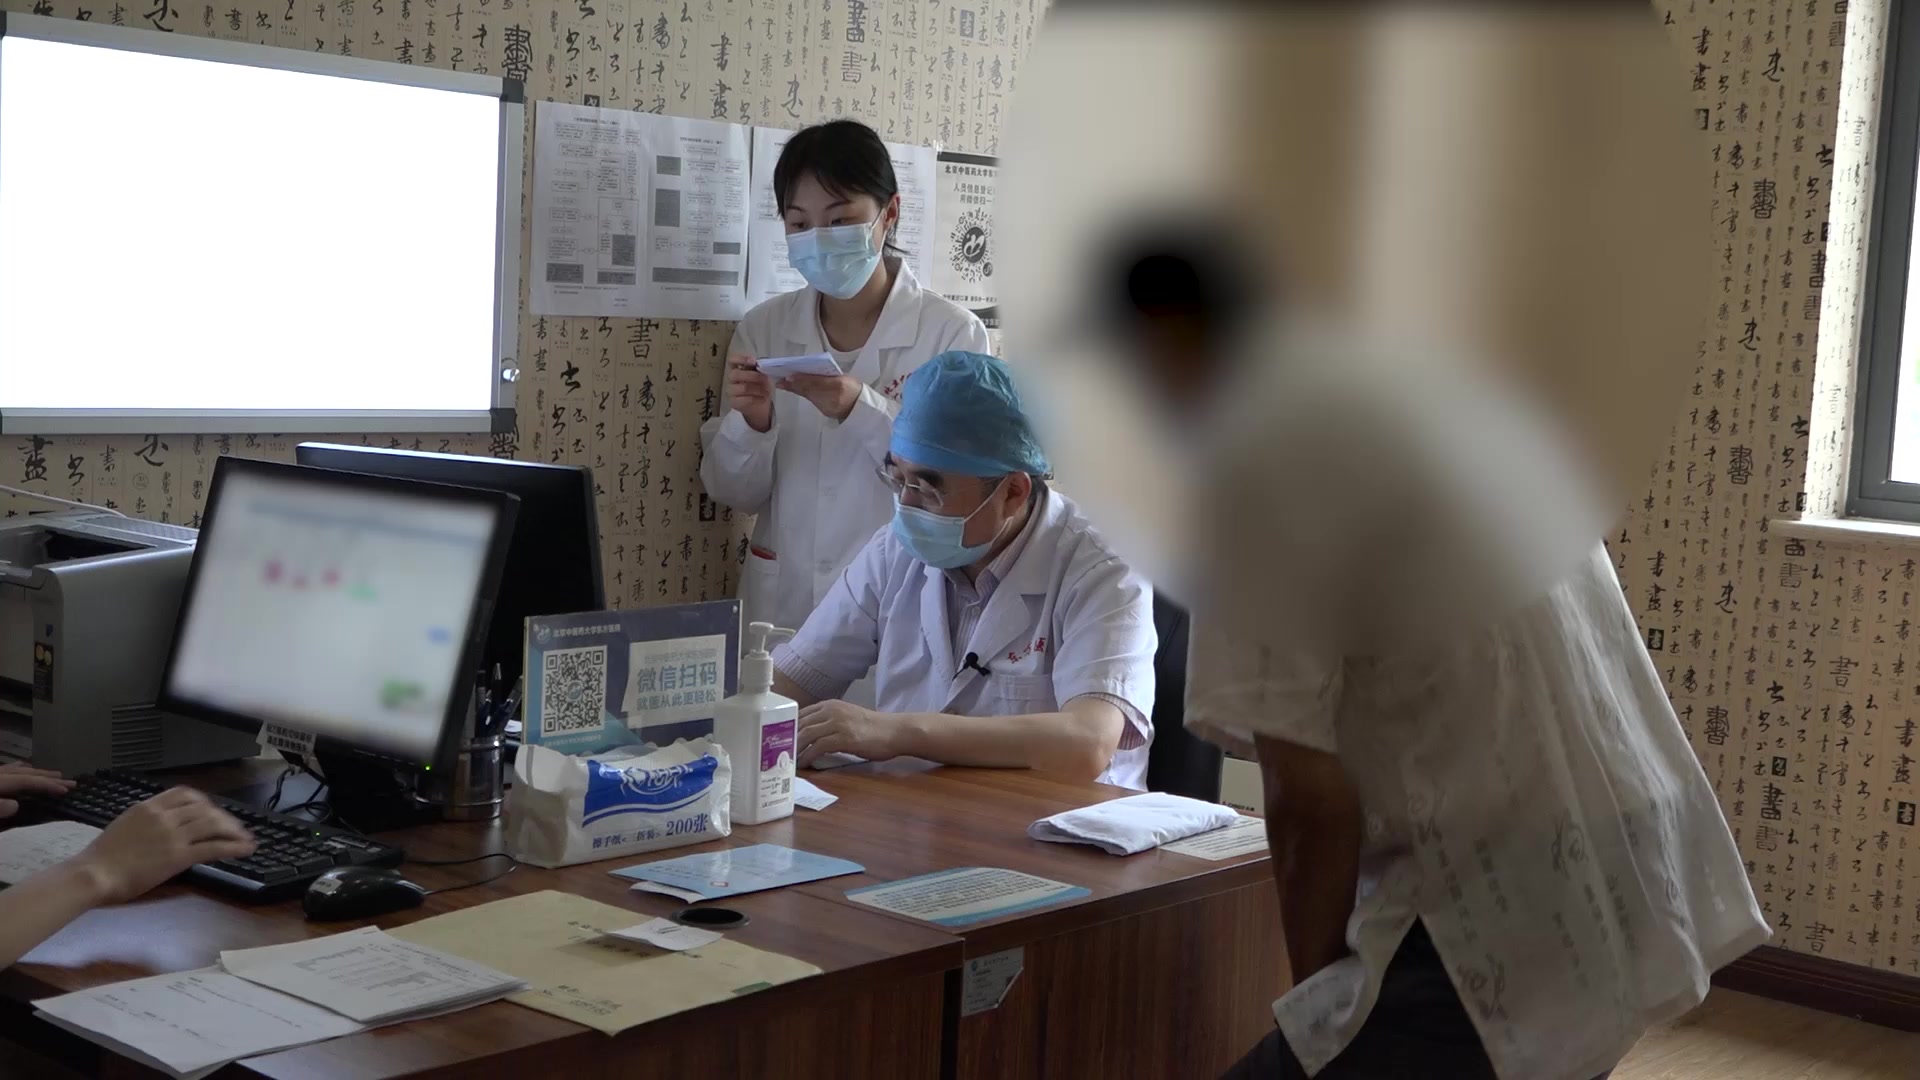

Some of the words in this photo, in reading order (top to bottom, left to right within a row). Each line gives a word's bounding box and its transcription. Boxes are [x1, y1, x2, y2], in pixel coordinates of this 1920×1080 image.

[945, 165, 997, 177] 北京中医药大学东
[953, 182, 995, 196] 人员信息登记
[960, 194, 995, 205] 用微信扫一
[637, 661, 718, 694] 微信扫码
[636, 690, 717, 712] 就医从此更轻松
[665, 813, 709, 837] 200张
